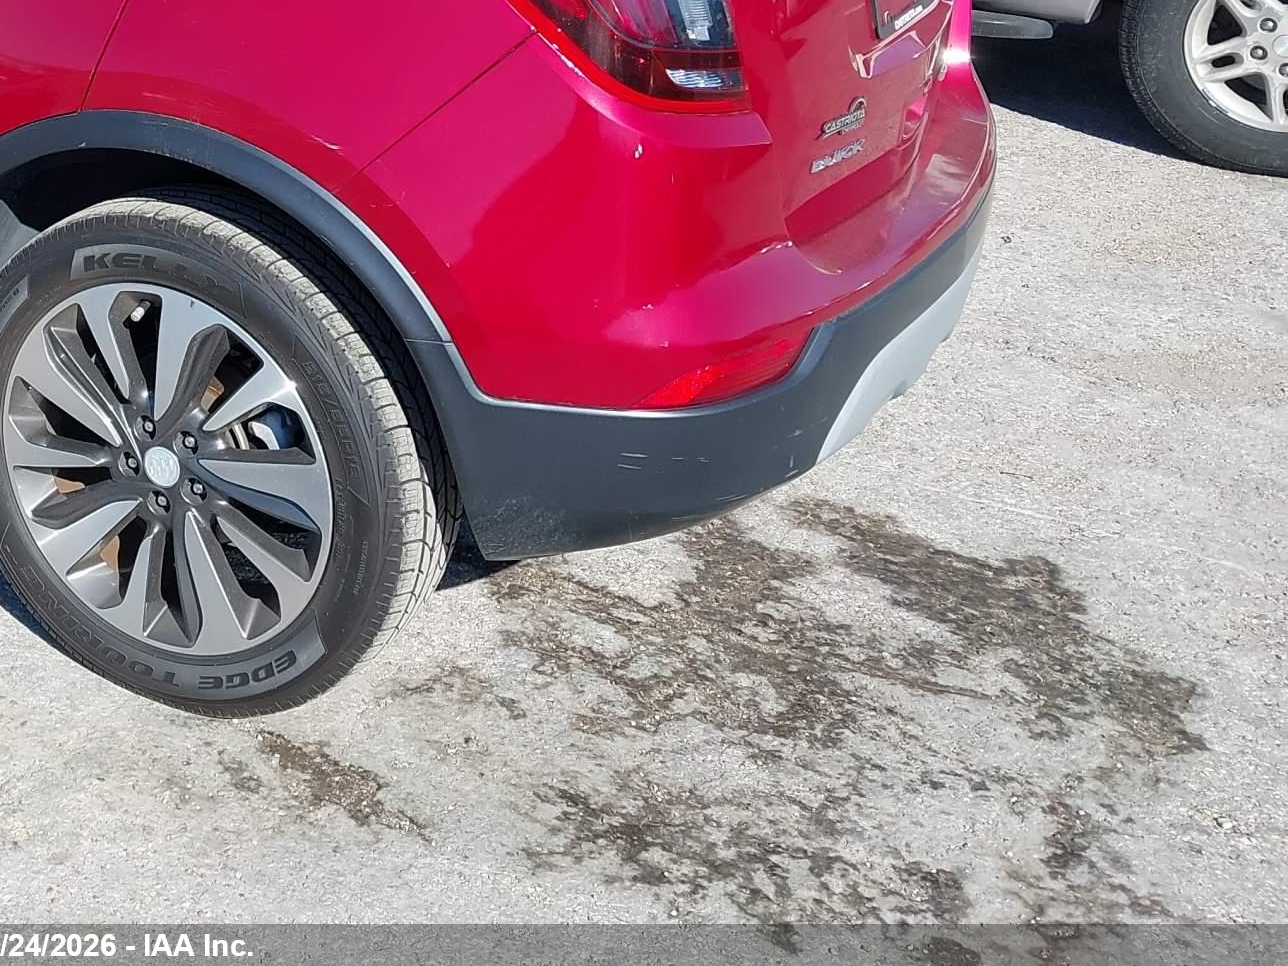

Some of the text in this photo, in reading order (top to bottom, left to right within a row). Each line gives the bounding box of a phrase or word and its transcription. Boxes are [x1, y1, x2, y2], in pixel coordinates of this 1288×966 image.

[824, 108, 866, 134] CASTRIOTA
[810, 138, 866, 174] BUICK
[83, 251, 233, 294] KELLY
[197, 649, 297, 690] EDGE
